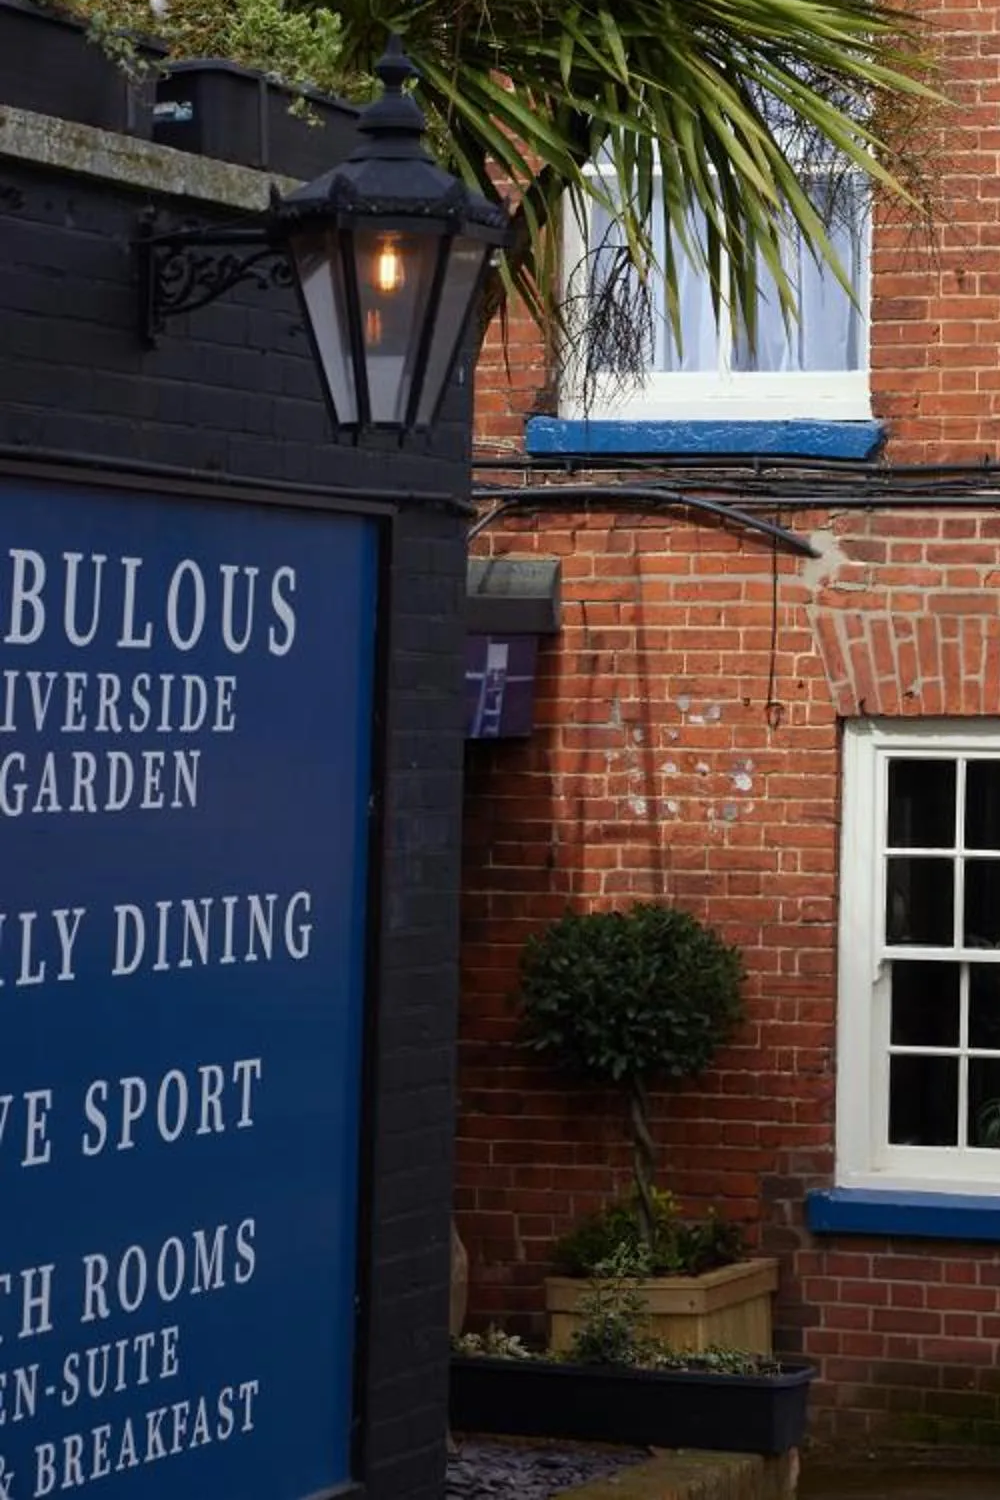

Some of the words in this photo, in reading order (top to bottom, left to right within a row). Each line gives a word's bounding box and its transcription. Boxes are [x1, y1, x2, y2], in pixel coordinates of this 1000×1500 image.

[4, 548, 298, 656] BULOUS
[0, 670, 237, 733] IVERSIDE
[0, 749, 202, 817] GARDEN
[0, 907, 86, 987] LY
[112, 891, 313, 976] DINING
[82, 1058, 262, 1156] SPORT
[81, 1218, 256, 1323] ROOMS
[34, 1380, 259, 1499] BREAKFAST
